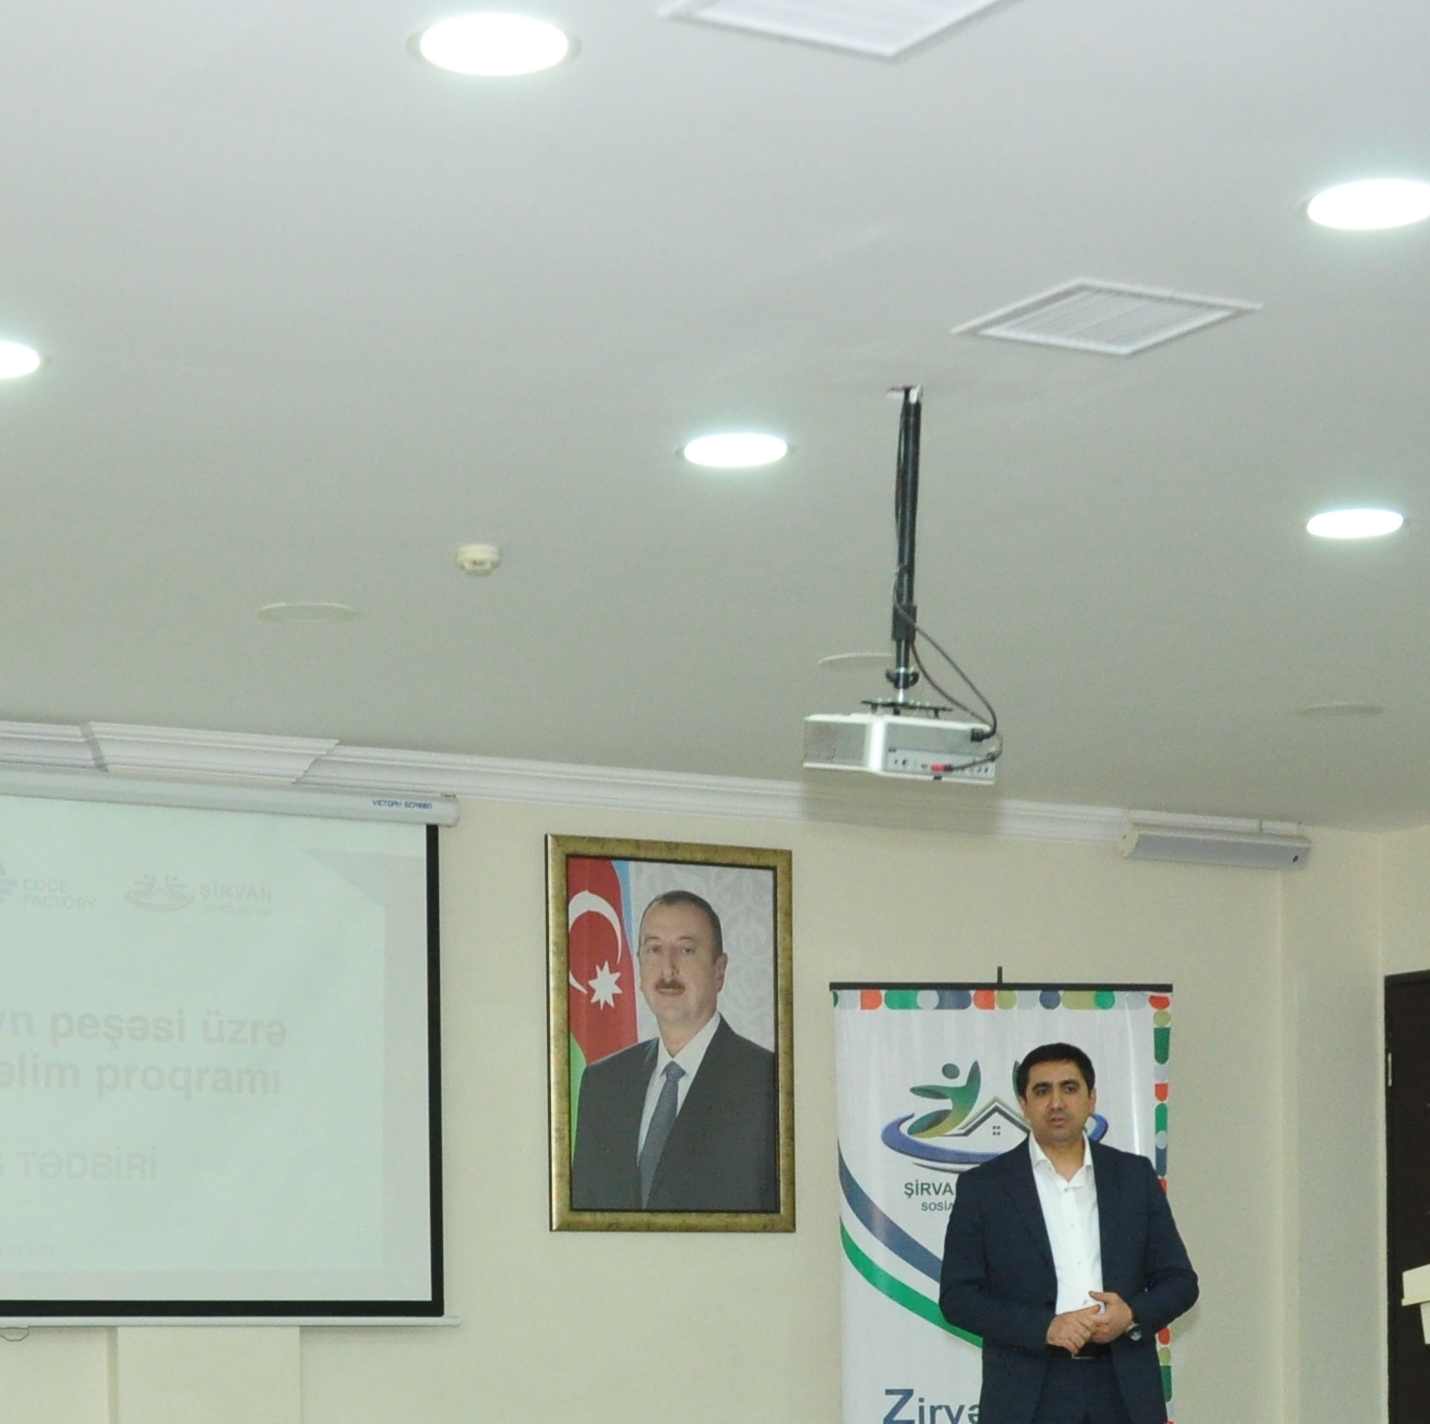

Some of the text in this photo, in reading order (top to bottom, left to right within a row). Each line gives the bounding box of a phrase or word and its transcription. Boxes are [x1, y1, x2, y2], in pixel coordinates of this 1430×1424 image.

[23, 878, 69, 893] CODE
[23, 893, 97, 910] FACTORY
[50, 1009, 186, 1050] peşəsi
[201, 1009, 287, 1048] üzrə
[16, 1145, 158, 1181] TƏDBİRİ
[903, 1178, 955, 1199] ŞİRVA
